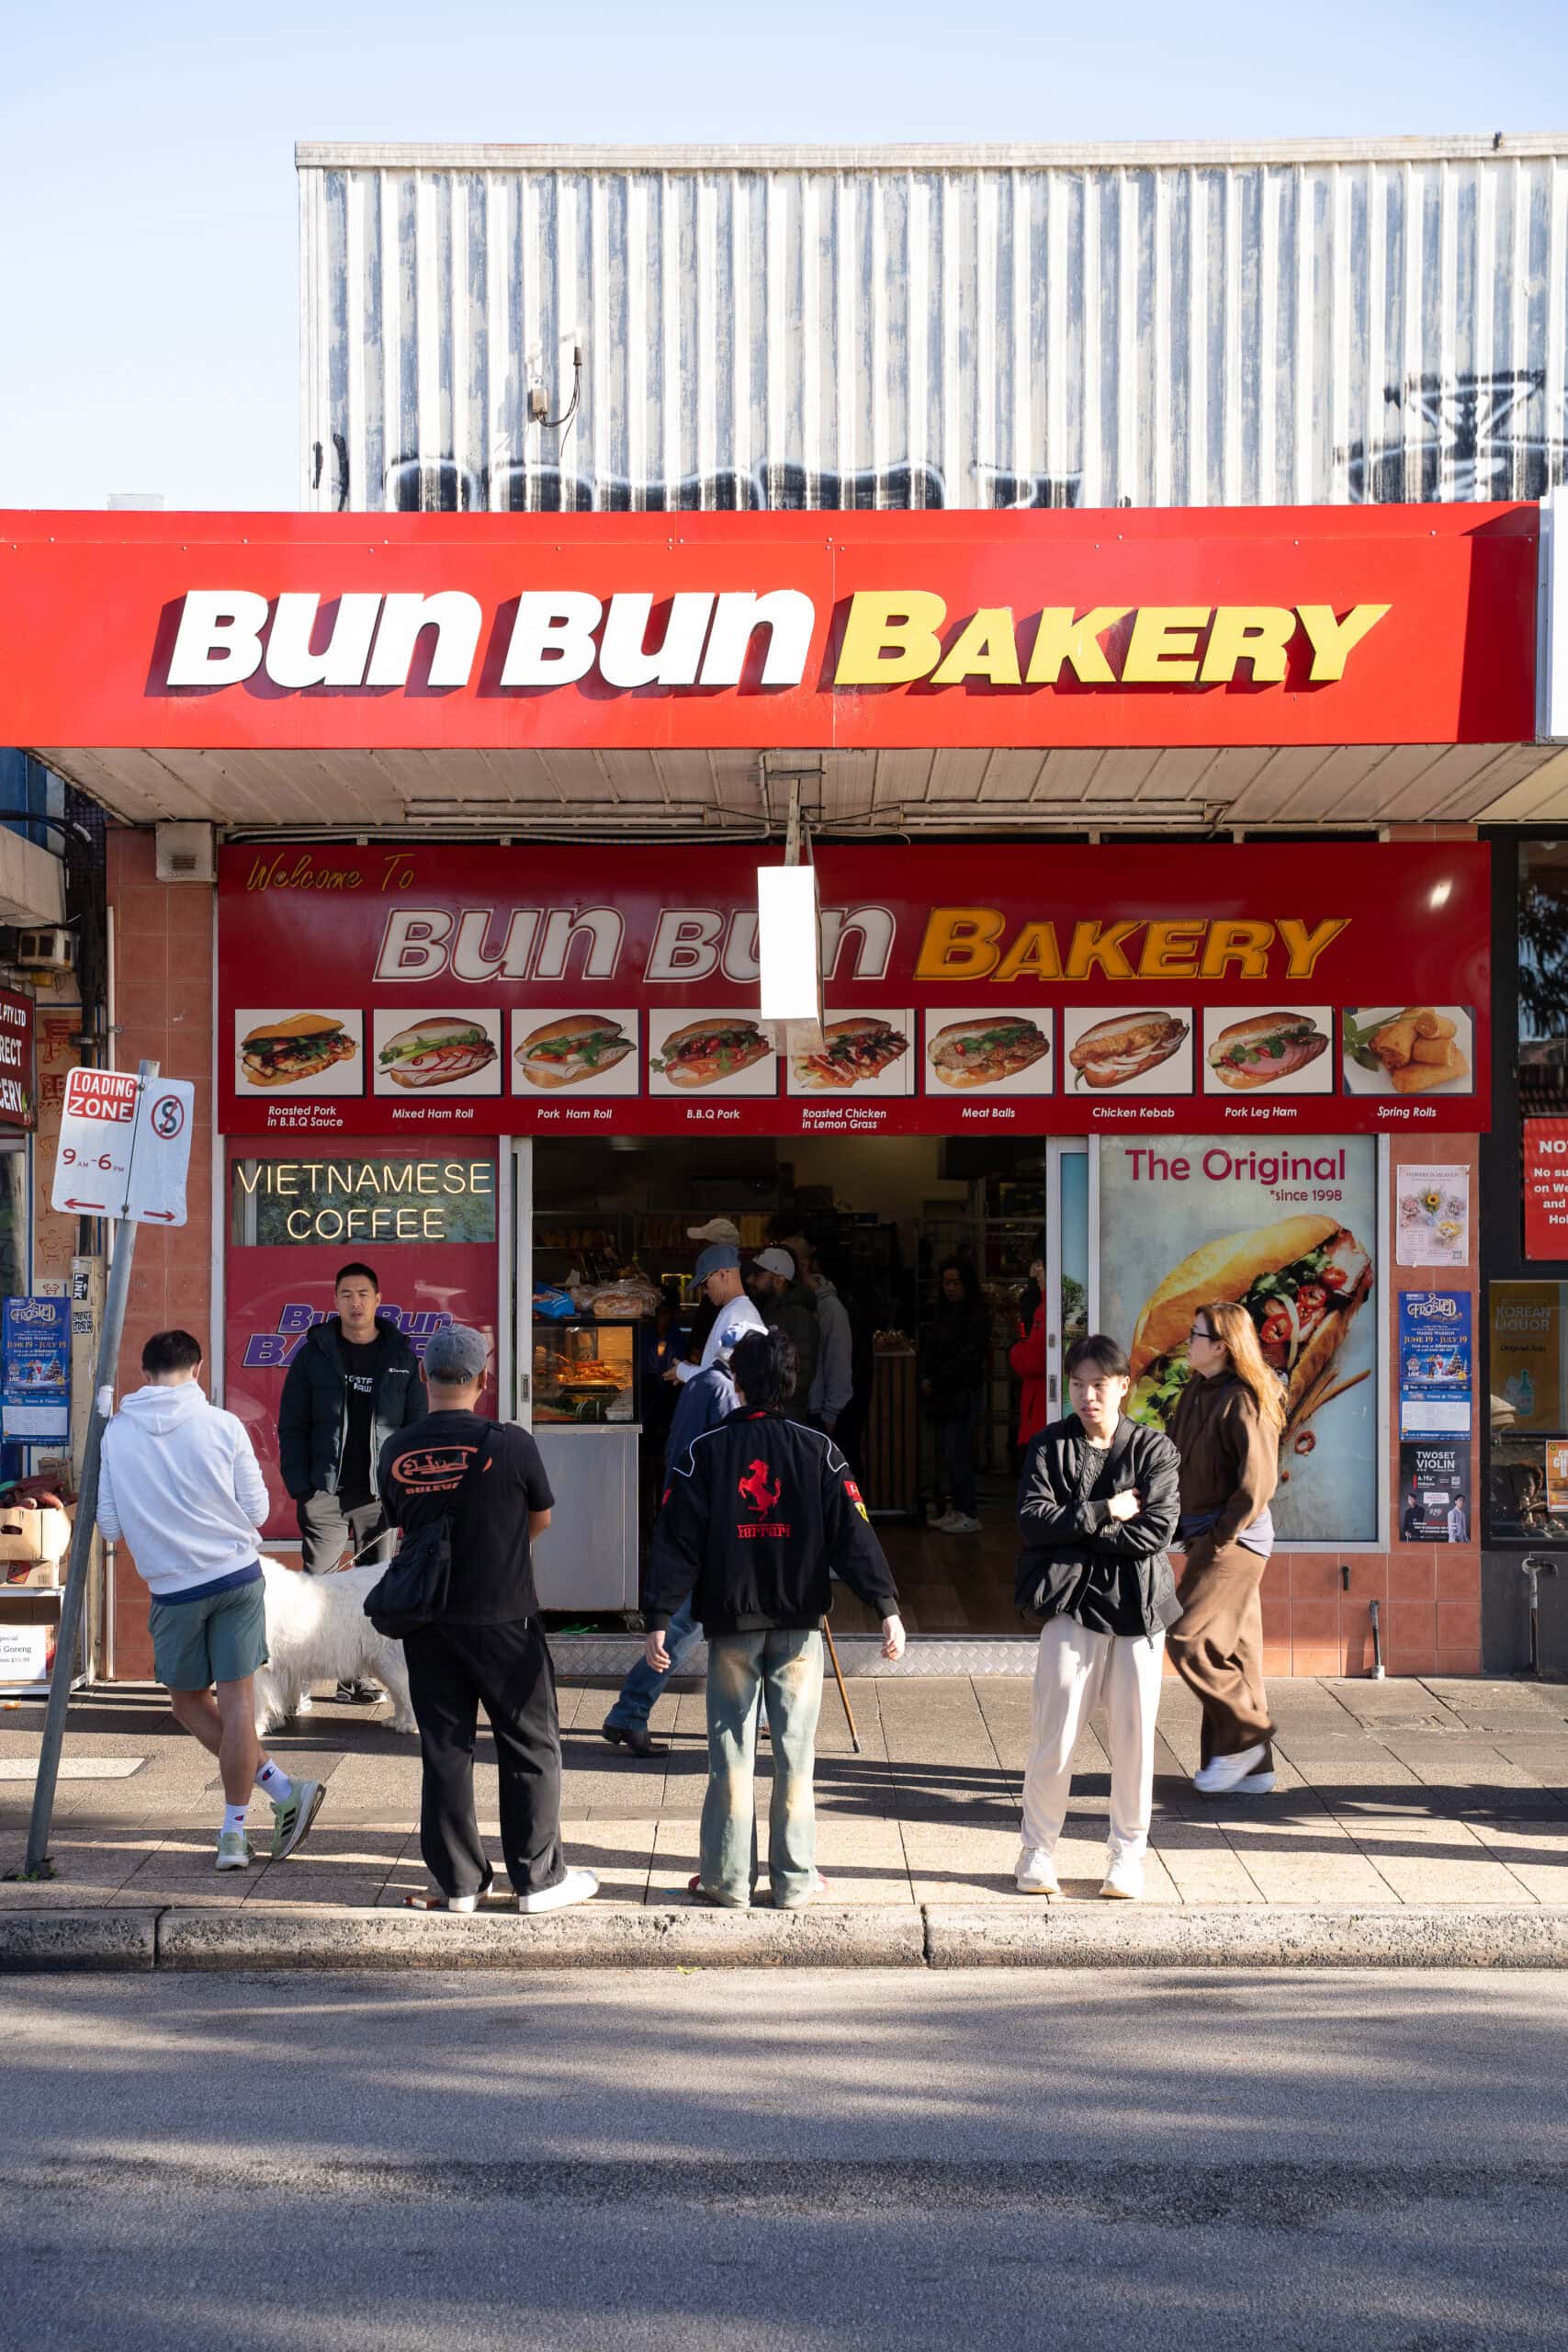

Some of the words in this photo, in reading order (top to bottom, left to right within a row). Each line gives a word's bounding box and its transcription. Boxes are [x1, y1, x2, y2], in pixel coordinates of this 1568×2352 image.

[833, 589, 1393, 686] BAKERY
[246, 854, 364, 891] Welcome
[381, 853, 415, 891] To
[912, 906, 1353, 982] BAKERY
[73, 1073, 135, 1098] LOADING
[69, 1095, 134, 1121] ZONE
[268, 1105, 311, 1116] Roasted
[313, 1105, 337, 1116] Pork
[392, 1108, 424, 1119] Mixed
[427, 1108, 452, 1118] Ham
[455, 1108, 474, 1118] Roll
[802, 1108, 843, 1118] Roasted
[845, 1108, 887, 1118] Chicken
[962, 1107, 989, 1118] Meat
[992, 1107, 1016, 1118] Balls
[1092, 1107, 1137, 1118] Chicken
[1140, 1107, 1176, 1118] Kebab
[1224, 1106, 1248, 1117] Pork
[1250, 1107, 1270, 1119] Leg
[1272, 1106, 1297, 1117] Ham
[1377, 1105, 1410, 1119] Spring
[1413, 1106, 1437, 1117] Rolls
[537, 1109, 560, 1119] Pork
[566, 1109, 591, 1119] Ham
[593, 1109, 613, 1119] Roll
[686, 1109, 715, 1120] B.B.Q
[716, 1109, 740, 1119] Pork
[267, 1116, 276, 1126] in
[279, 1116, 308, 1127] B.B.Q
[310, 1116, 344, 1127] Sauce
[802, 1119, 811, 1128] in
[813, 1119, 847, 1129] Lemon
[850, 1119, 877, 1129] Grass
[1540, 1140, 1568, 1154] NO
[1124, 1148, 1190, 1181] The
[1201, 1148, 1346, 1185] Original
[1534, 1168, 1551, 1177] No
[237, 1163, 492, 1194] VIETNAMESE
[1534, 1184, 1550, 1193] on
[1312, 1189, 1343, 1202] 1998
[1543, 1199, 1565, 1208] and
[287, 1208, 446, 1239] COFFEE
[1495, 1306, 1551, 1318] KOREAN
[1495, 1318, 1551, 1331] LIQUOR
[1416, 1451, 1456, 1460] TWOSET
[1416, 1459, 1456, 1469] VIOLIN
[4, 1645, 32, 1654] Goreng
